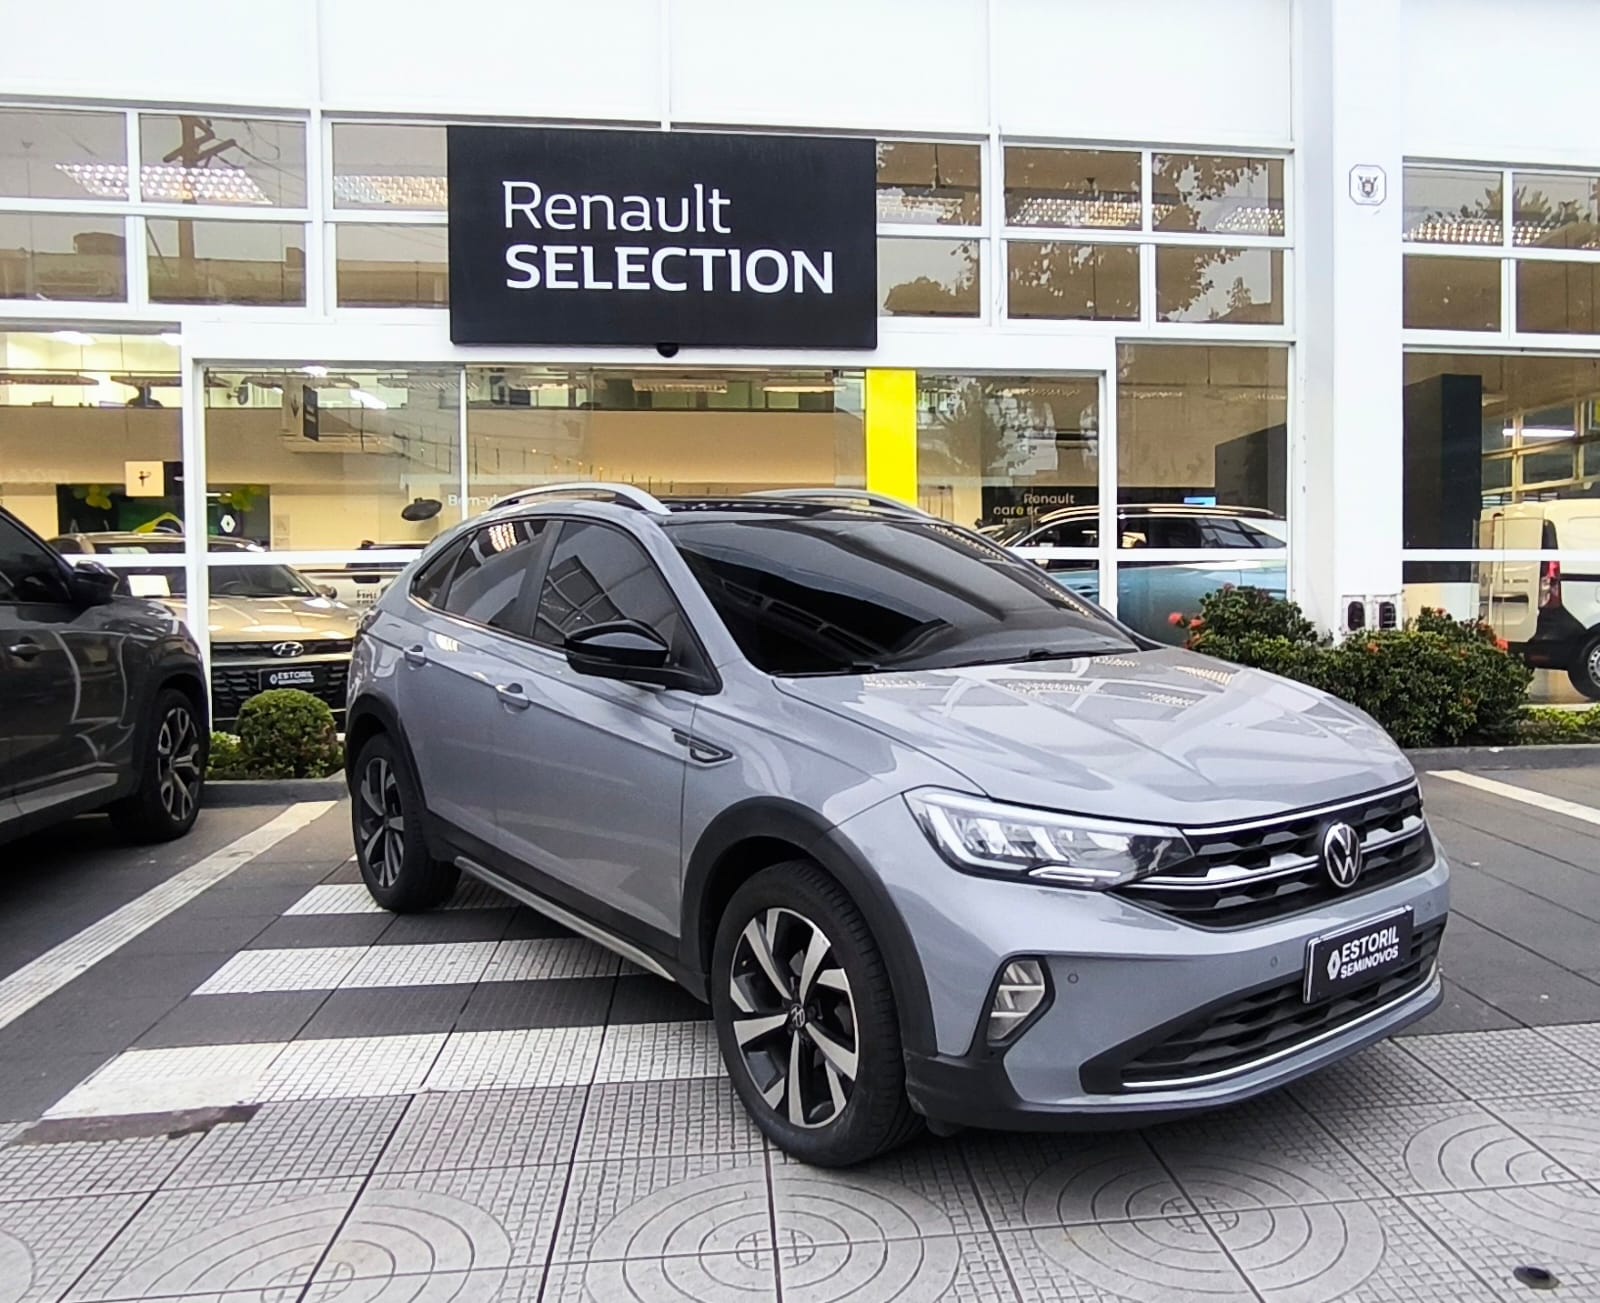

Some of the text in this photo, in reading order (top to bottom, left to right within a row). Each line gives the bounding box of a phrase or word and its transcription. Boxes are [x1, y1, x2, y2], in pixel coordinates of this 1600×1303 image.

[502, 181, 731, 234] Renault
[505, 244, 834, 294] SELECTION
[1023, 492, 1075, 504] Renault
[1340, 945, 1399, 979] SEMINOVOS
[1342, 925, 1400, 963] ESTORIL
